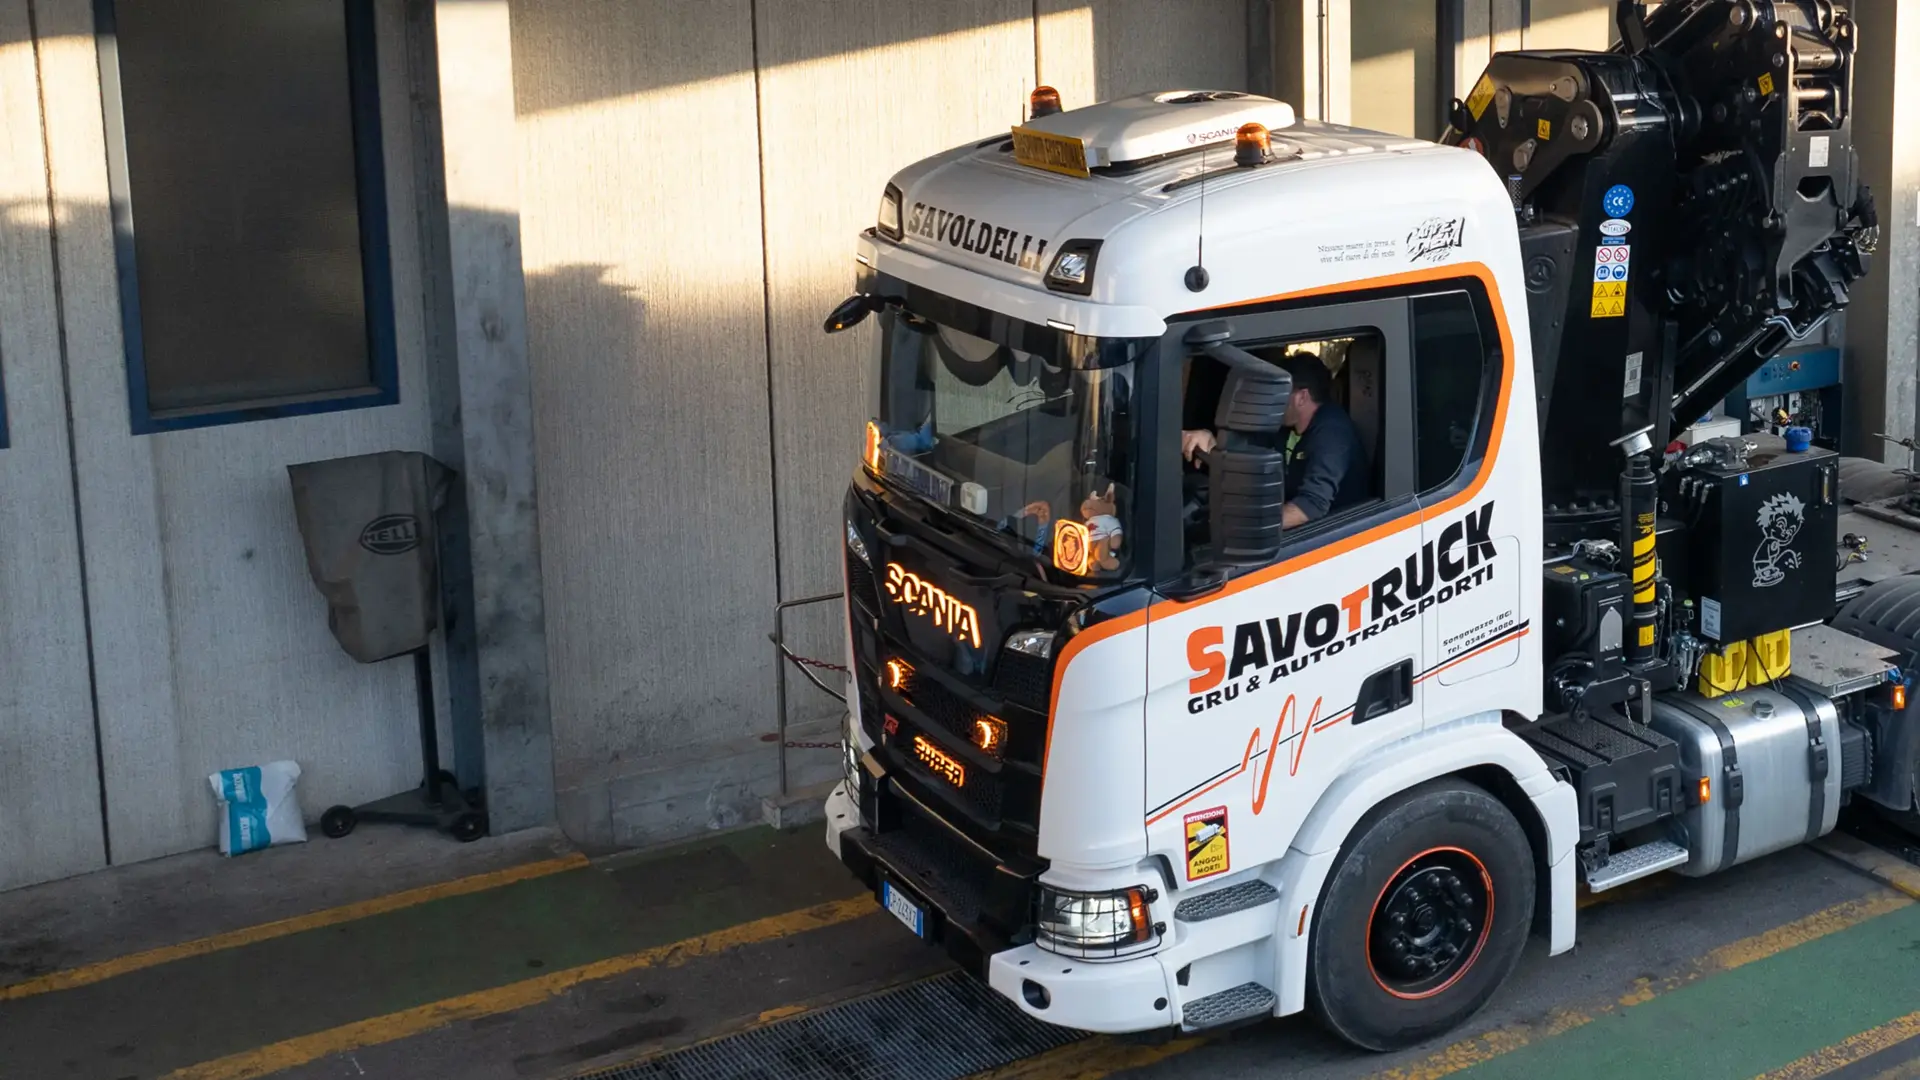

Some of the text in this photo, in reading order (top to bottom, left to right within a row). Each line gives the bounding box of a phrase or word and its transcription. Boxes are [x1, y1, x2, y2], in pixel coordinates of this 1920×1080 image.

[907, 202, 1048, 273] SAVOLDELLI
[885, 563, 981, 649] SCANIA
[1186, 500, 1497, 694] SAVOTRUCK
[1187, 563, 1493, 715] GRU & AUTOTRASPORTI
[1193, 854, 1223, 867] ANGOLI
[1196, 863, 1221, 875] MORTI
